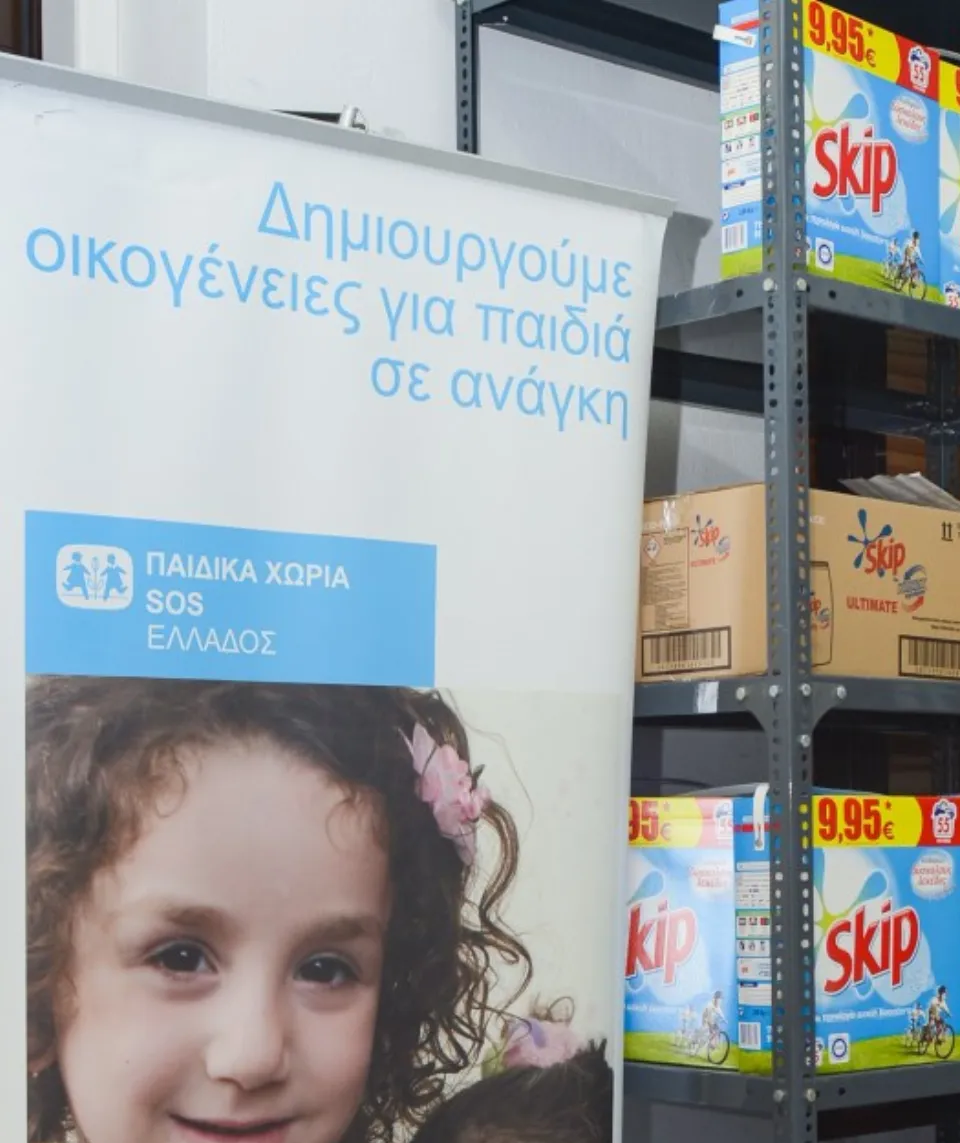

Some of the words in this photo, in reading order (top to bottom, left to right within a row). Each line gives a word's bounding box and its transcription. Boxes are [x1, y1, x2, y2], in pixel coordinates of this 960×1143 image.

[812, 122, 897, 214] Skip
[258, 181, 633, 304] Δημιουργούμε
[26, 226, 361, 335] οικογένειες
[380, 287, 455, 341] για
[475, 302, 632, 363] παιδιά
[371, 356, 432, 402] σε
[451, 365, 629, 441] ανάγκη
[146, 551, 258, 584] ΠΑΙΔΙΚΑ
[264, 560, 350, 589] ΧΩΡΙΑ
[863, 537, 906, 577] Skip
[145, 588, 204, 616] SOS
[147, 624, 276, 655] ΕΛΛΑΔΟΣ
[846, 595, 900, 614] ULTIMATE
[625, 898, 698, 986] kip
[823, 899, 920, 994] Skip
